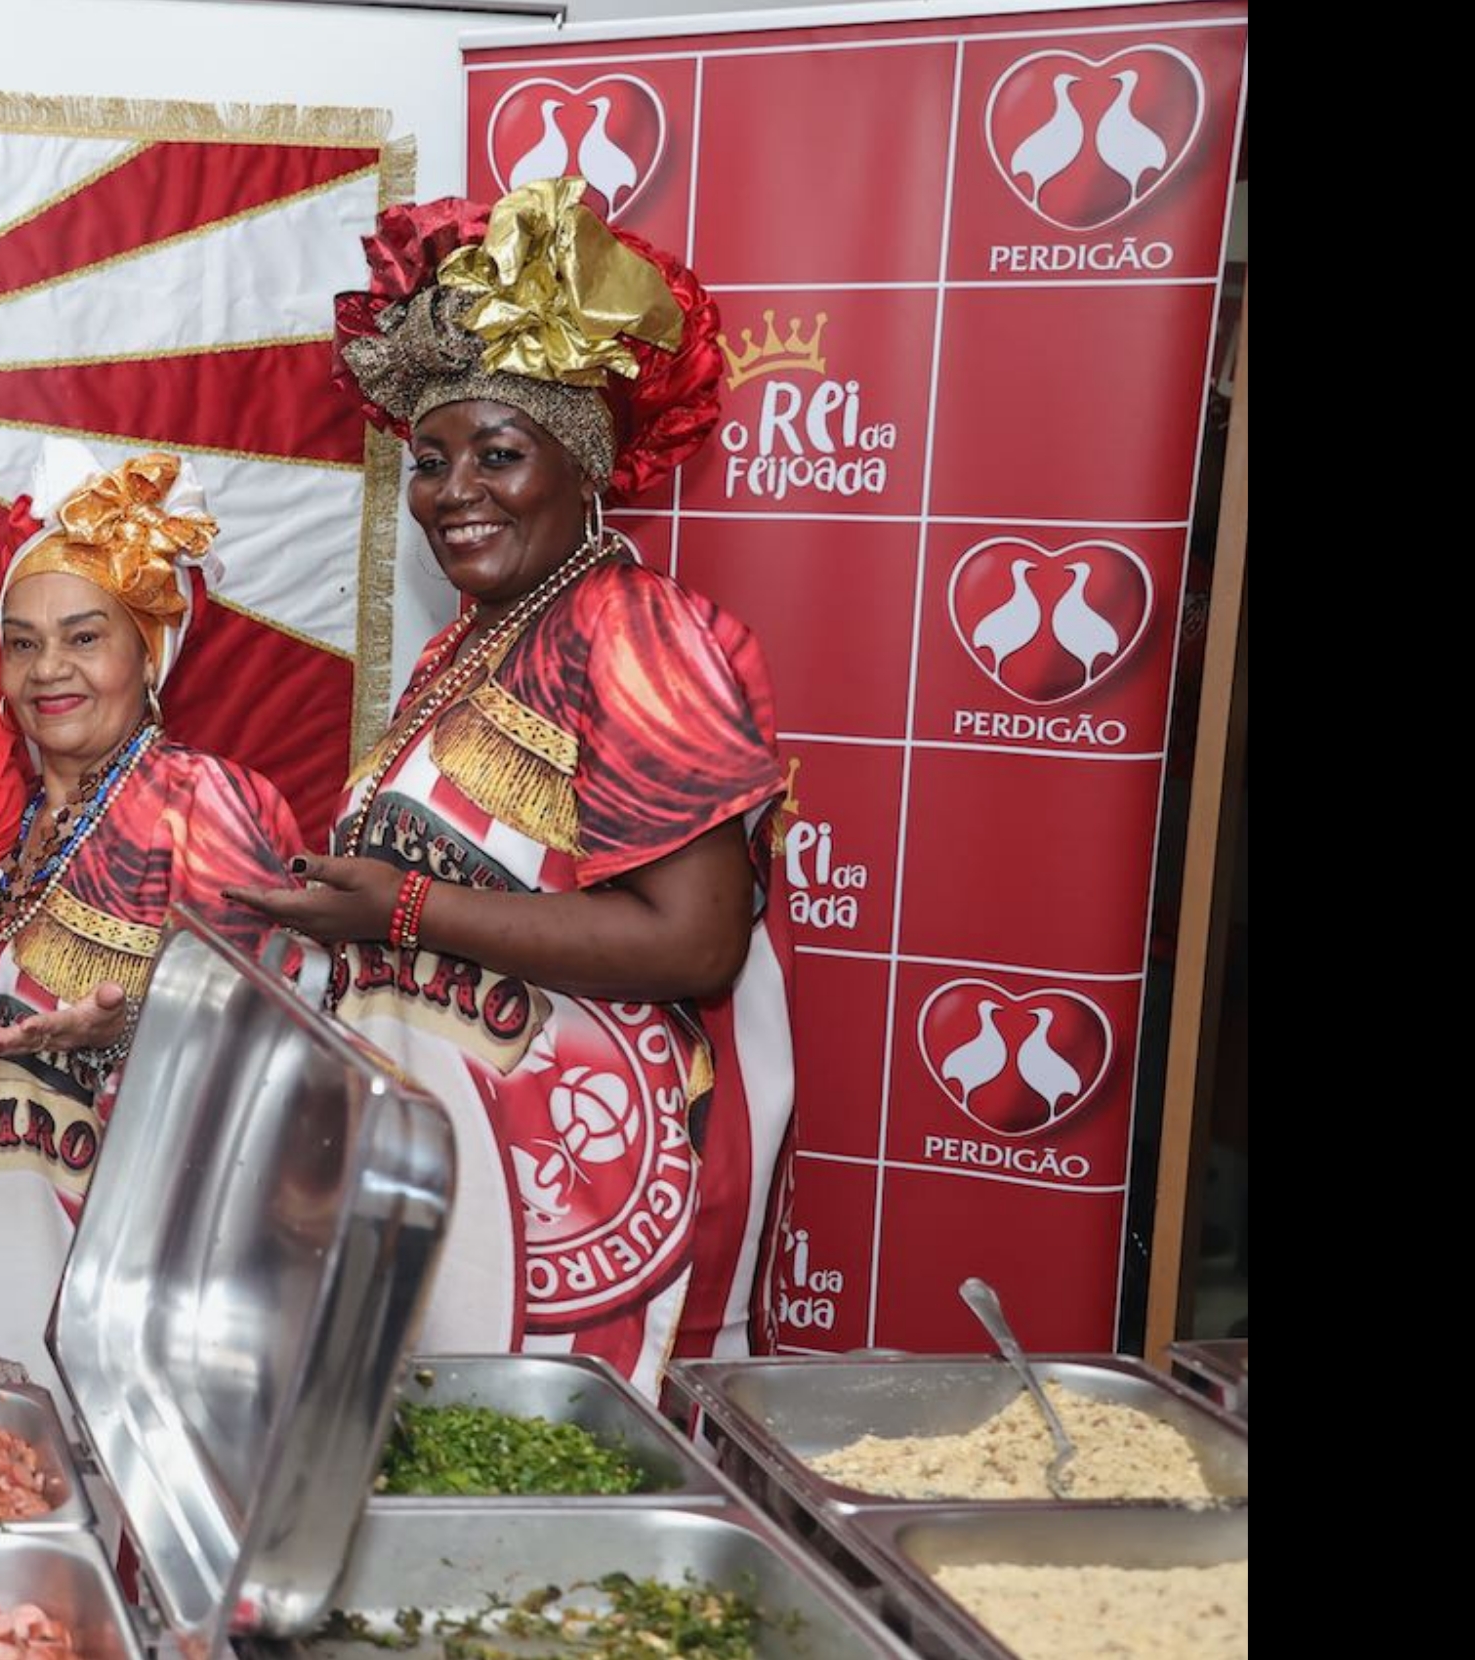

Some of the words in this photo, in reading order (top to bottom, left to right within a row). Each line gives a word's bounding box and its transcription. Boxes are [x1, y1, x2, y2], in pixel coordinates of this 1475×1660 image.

[988, 236, 1174, 273] PERDIGÃO
[759, 380, 859, 456] Rei
[859, 423, 897, 452] da
[726, 455, 887, 500] Feijoada
[953, 709, 1127, 746] PERDIGÃO
[832, 862, 868, 890] da
[924, 1135, 1091, 1179] PERDIGÃO
[808, 1268, 844, 1294] da
